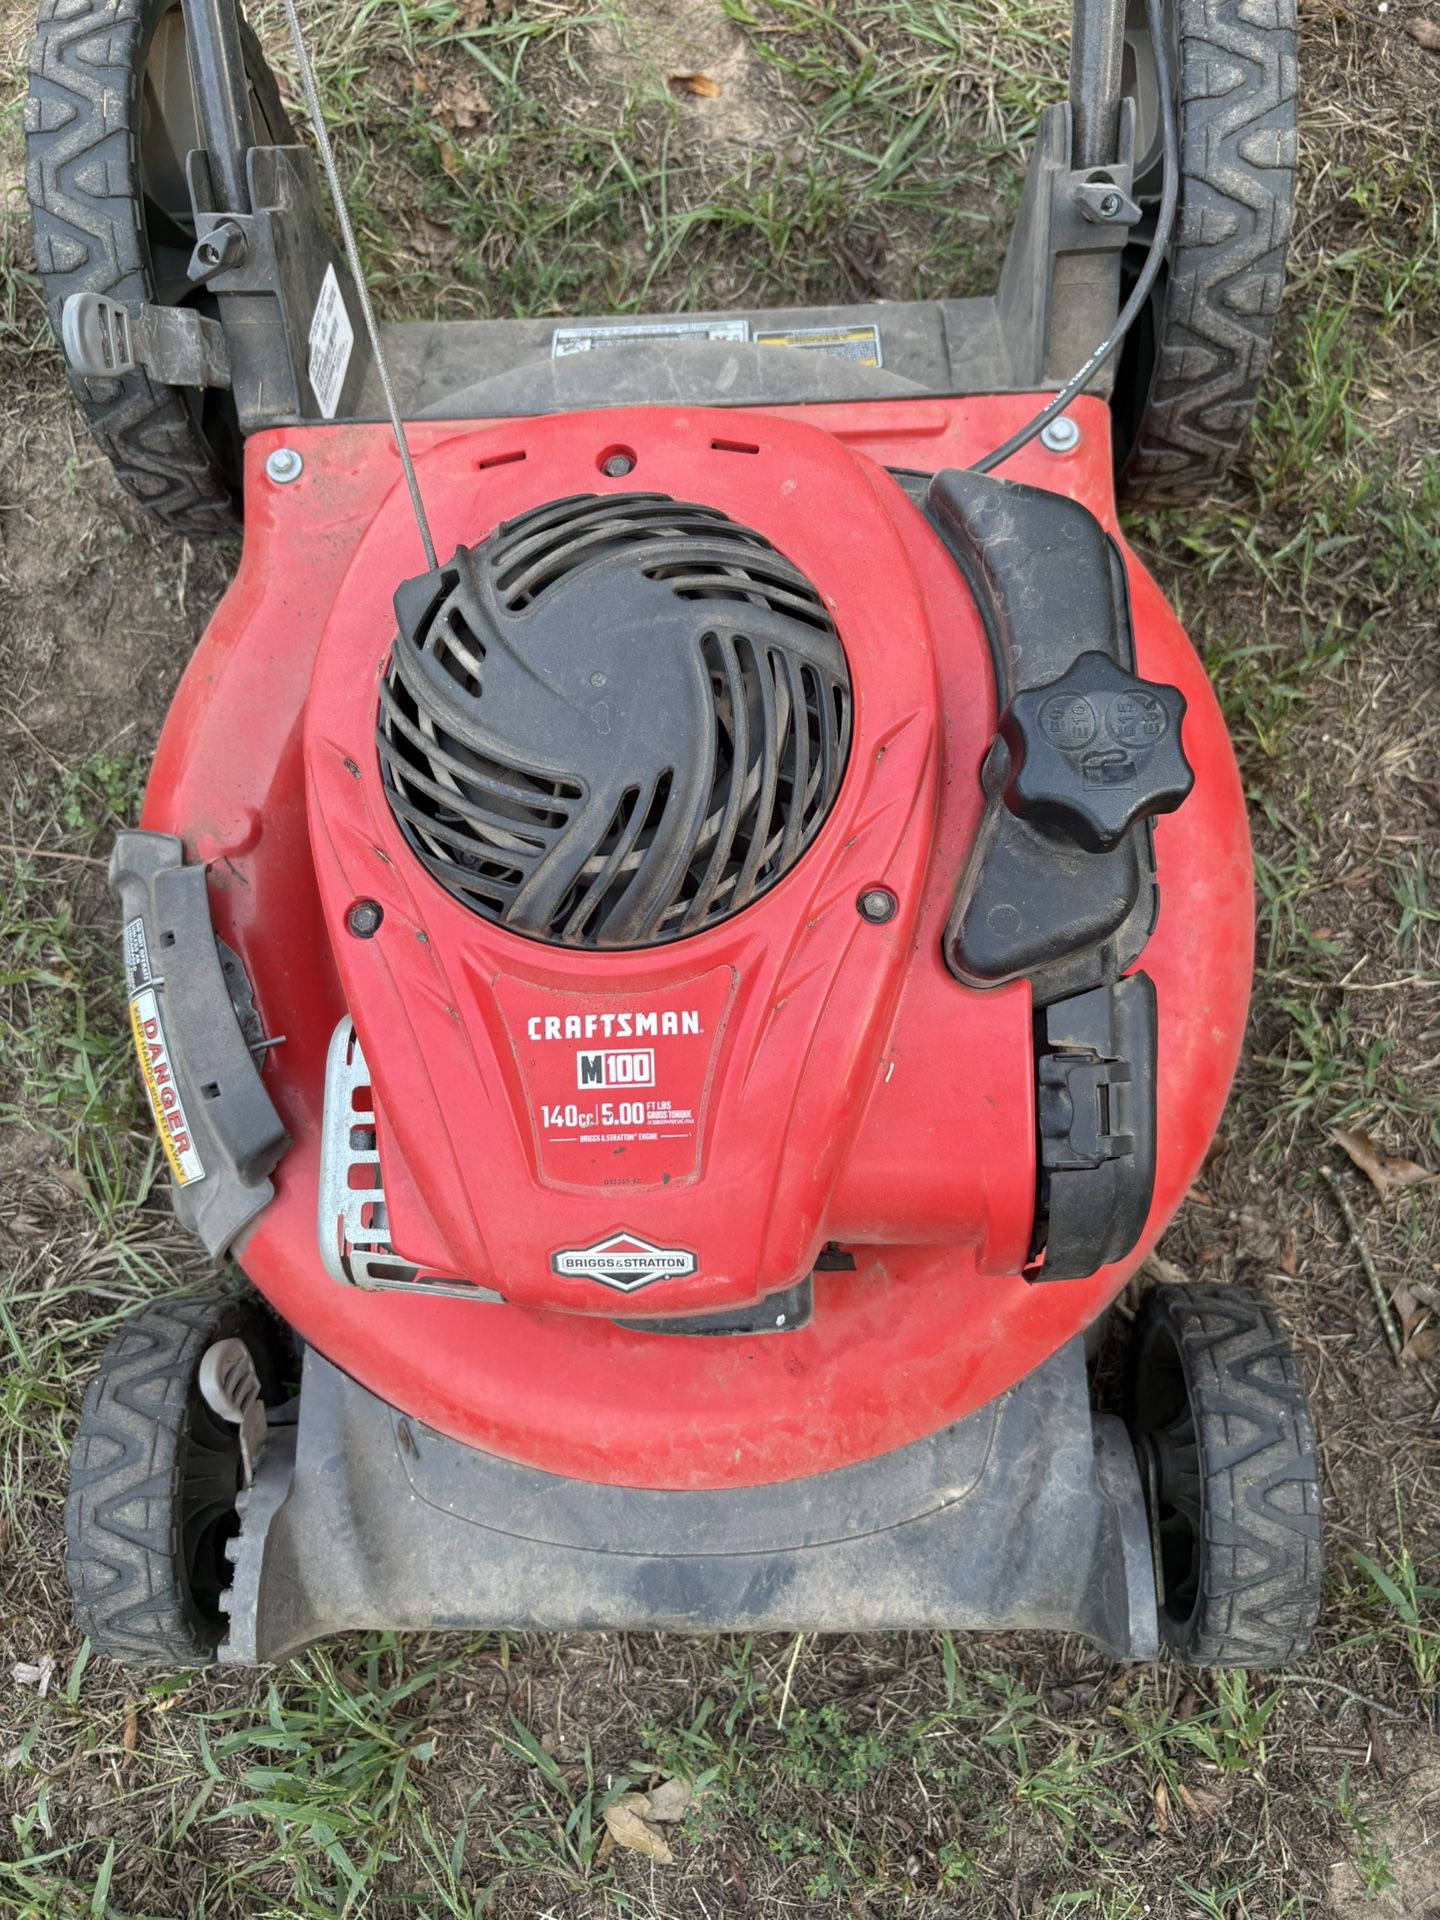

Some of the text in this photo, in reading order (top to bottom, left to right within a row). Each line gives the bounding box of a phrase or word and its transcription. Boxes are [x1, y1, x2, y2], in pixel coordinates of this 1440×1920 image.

[1072, 704, 1088, 738] E10
[528, 1011, 699, 1040] CRAFTSMAN
[581, 1054, 650, 1084] M100
[133, 1006, 186, 1178] KEEP HANDS and FEET AWAY
[143, 1017, 191, 1156] DANGER
[601, 1101, 645, 1126] 5.00
[646, 1101, 671, 1110] FT LBS
[668, 1109, 693, 1119] TORQUE
[580, 1134, 601, 1143] BRIGGS
[638, 1132, 658, 1140] ENGINE
